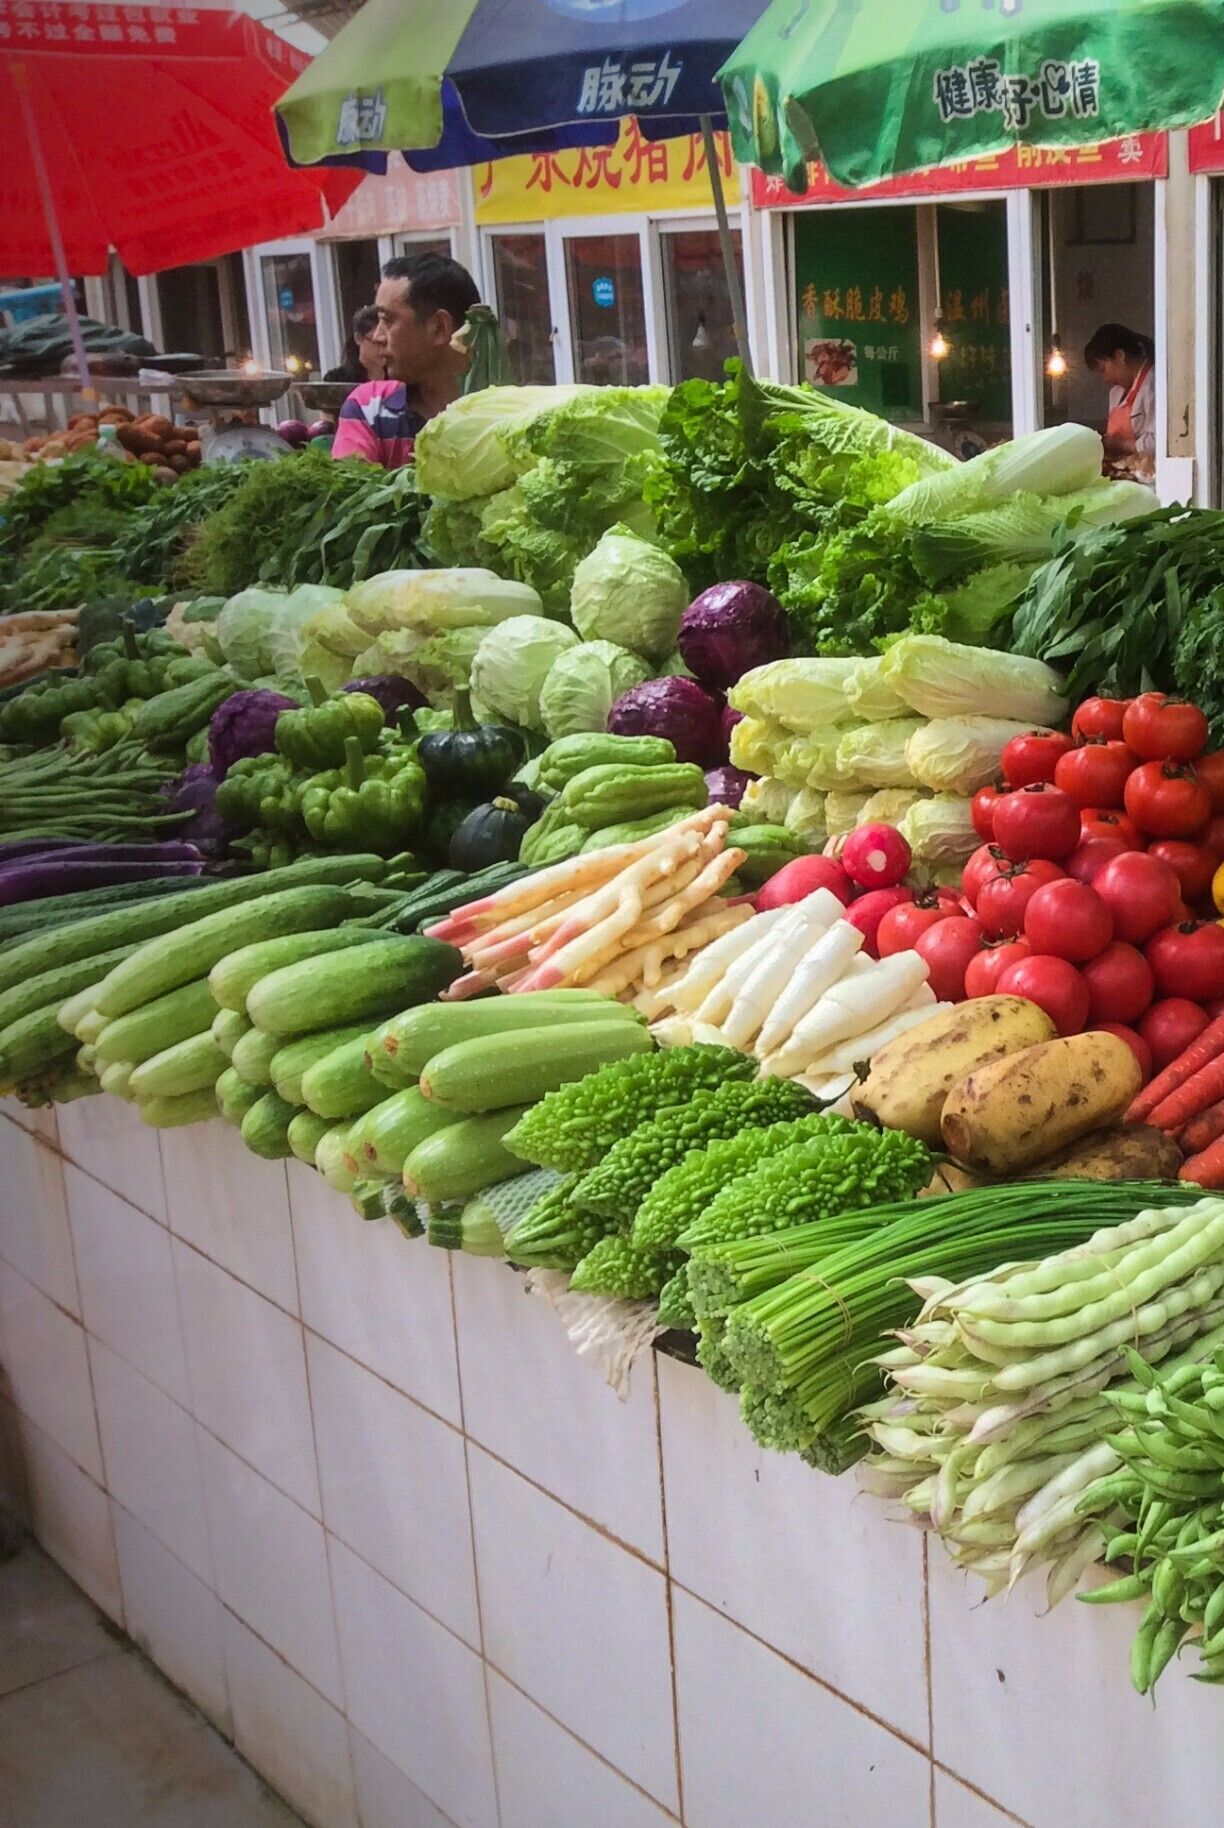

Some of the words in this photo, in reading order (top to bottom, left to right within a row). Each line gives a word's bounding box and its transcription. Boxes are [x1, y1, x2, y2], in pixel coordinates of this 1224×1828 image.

[576, 50, 683, 114] 脉动
[934, 57, 1101, 131] 健康好心情
